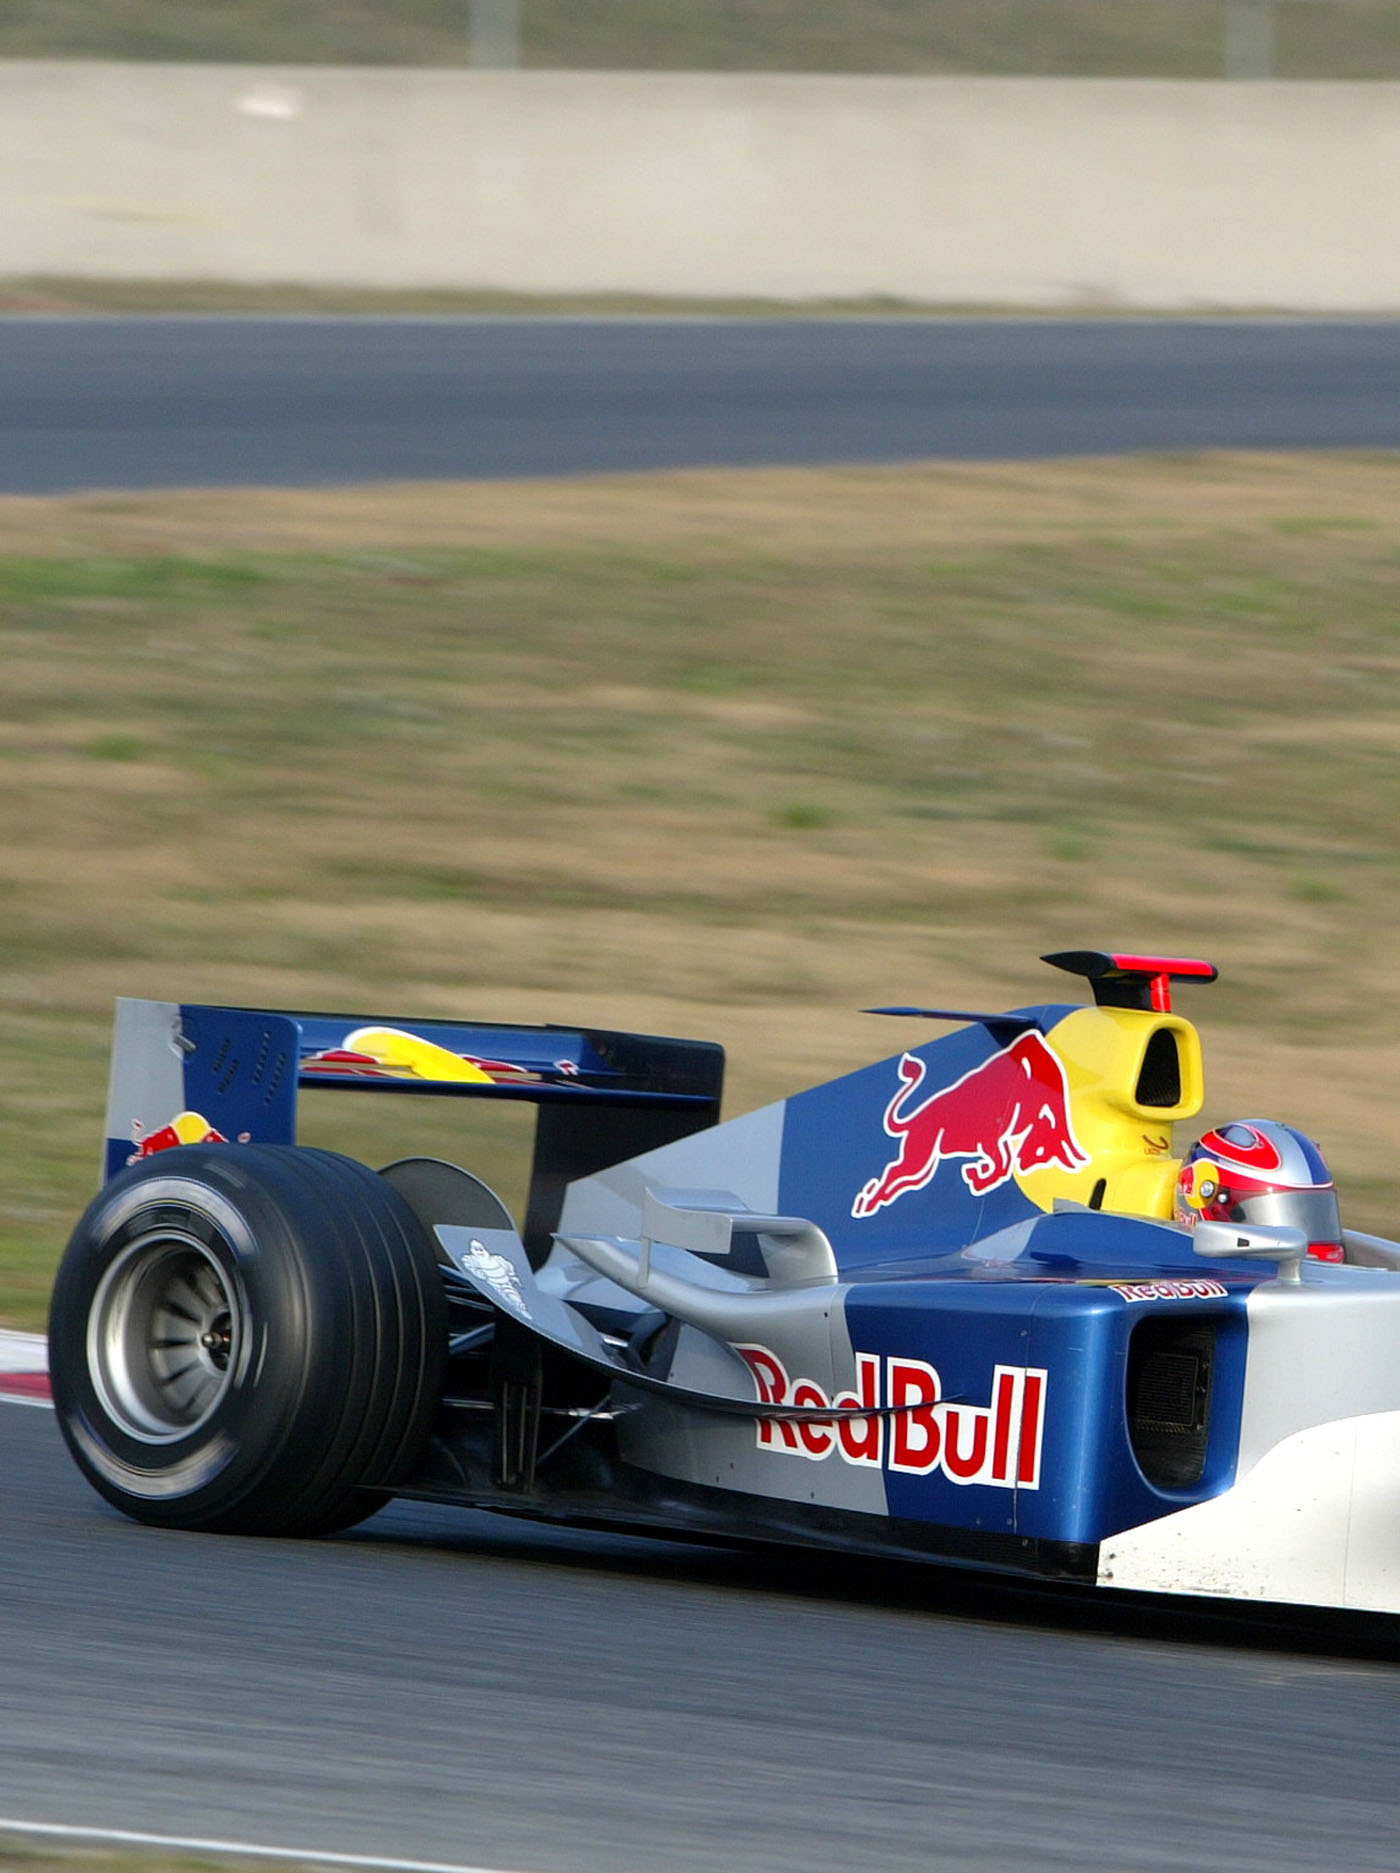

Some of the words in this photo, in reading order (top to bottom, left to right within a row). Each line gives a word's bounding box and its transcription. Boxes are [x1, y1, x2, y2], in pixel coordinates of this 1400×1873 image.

[1109, 1281, 1176, 1302] Red
[1173, 1279, 1228, 1299] Bull
[734, 1345, 881, 1466] Red
[889, 1360, 1044, 1485] Bull
